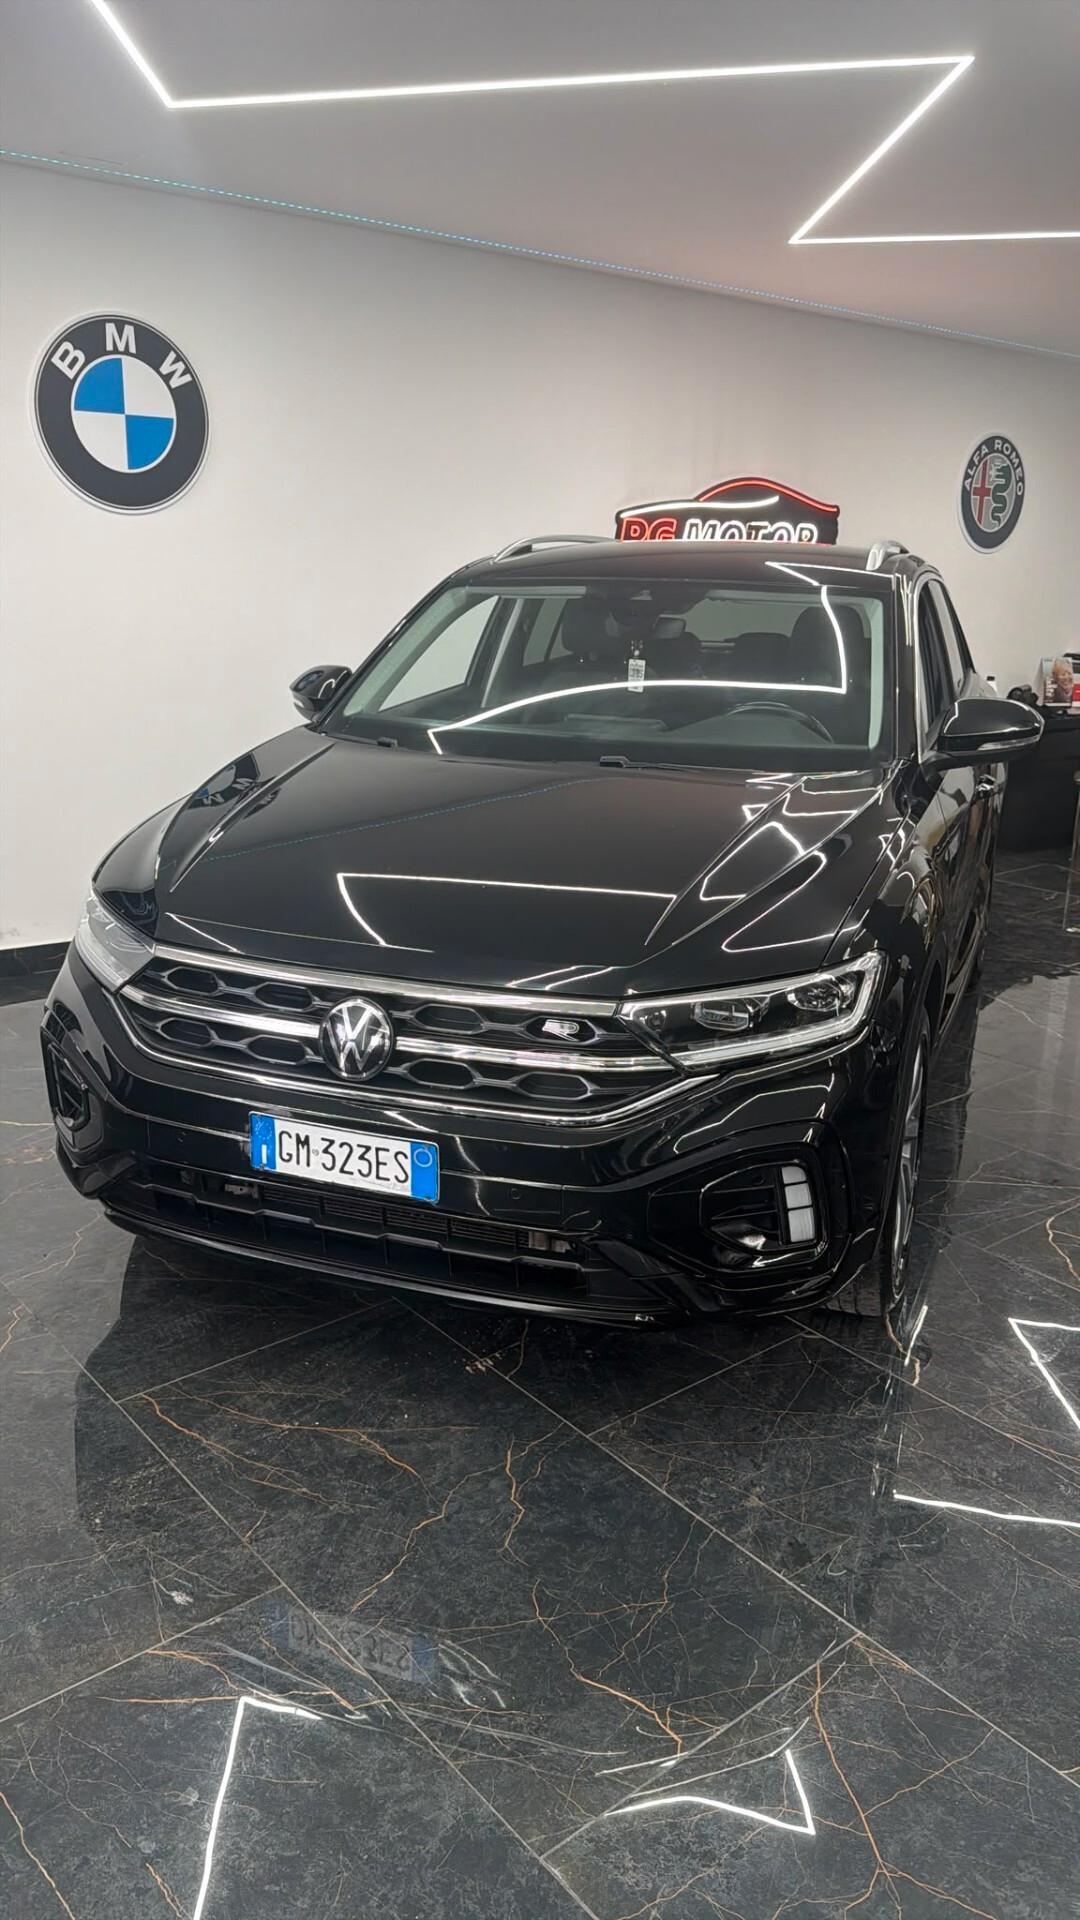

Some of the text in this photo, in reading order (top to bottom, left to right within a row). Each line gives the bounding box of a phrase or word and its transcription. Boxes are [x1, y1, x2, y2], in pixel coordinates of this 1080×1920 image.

[51, 322, 193, 389] BMW
[964, 440, 1024, 496] ALFA ROMEO
